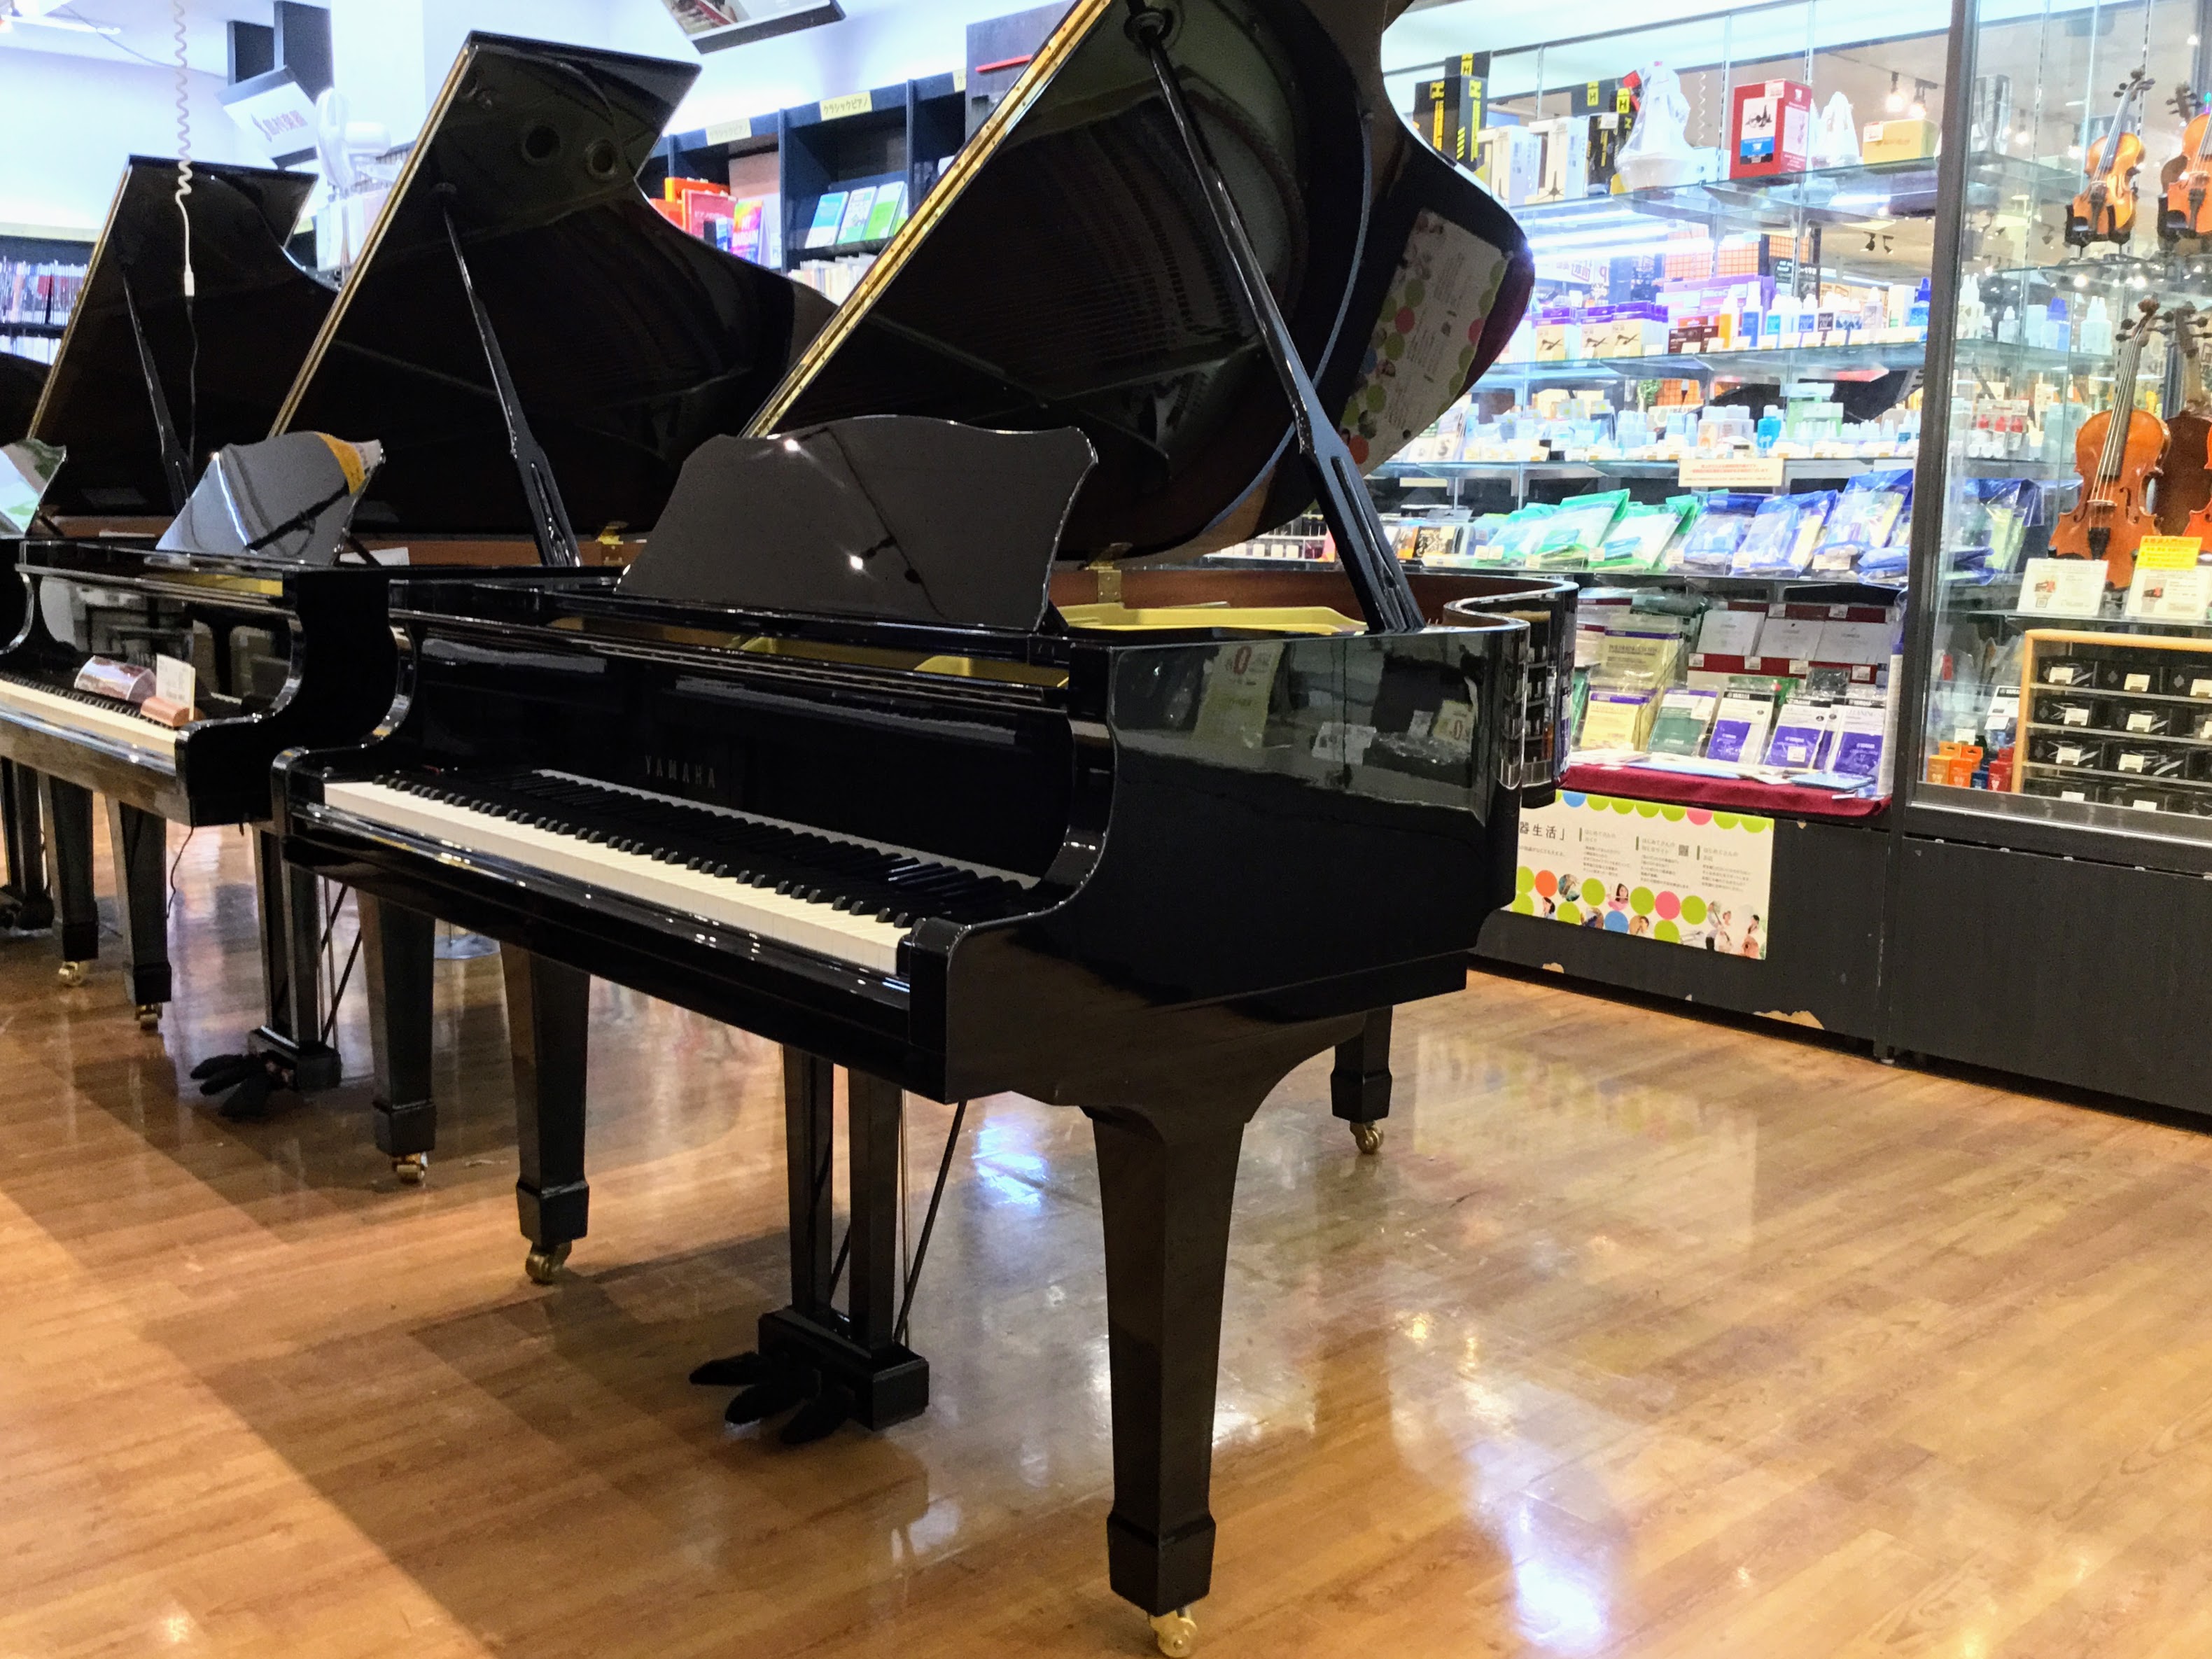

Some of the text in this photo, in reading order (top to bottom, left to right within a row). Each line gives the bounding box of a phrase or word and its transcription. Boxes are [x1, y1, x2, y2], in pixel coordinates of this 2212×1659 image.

[822, 97, 868, 114] クラシックピアノ
[645, 755, 716, 790] YAMAHA
